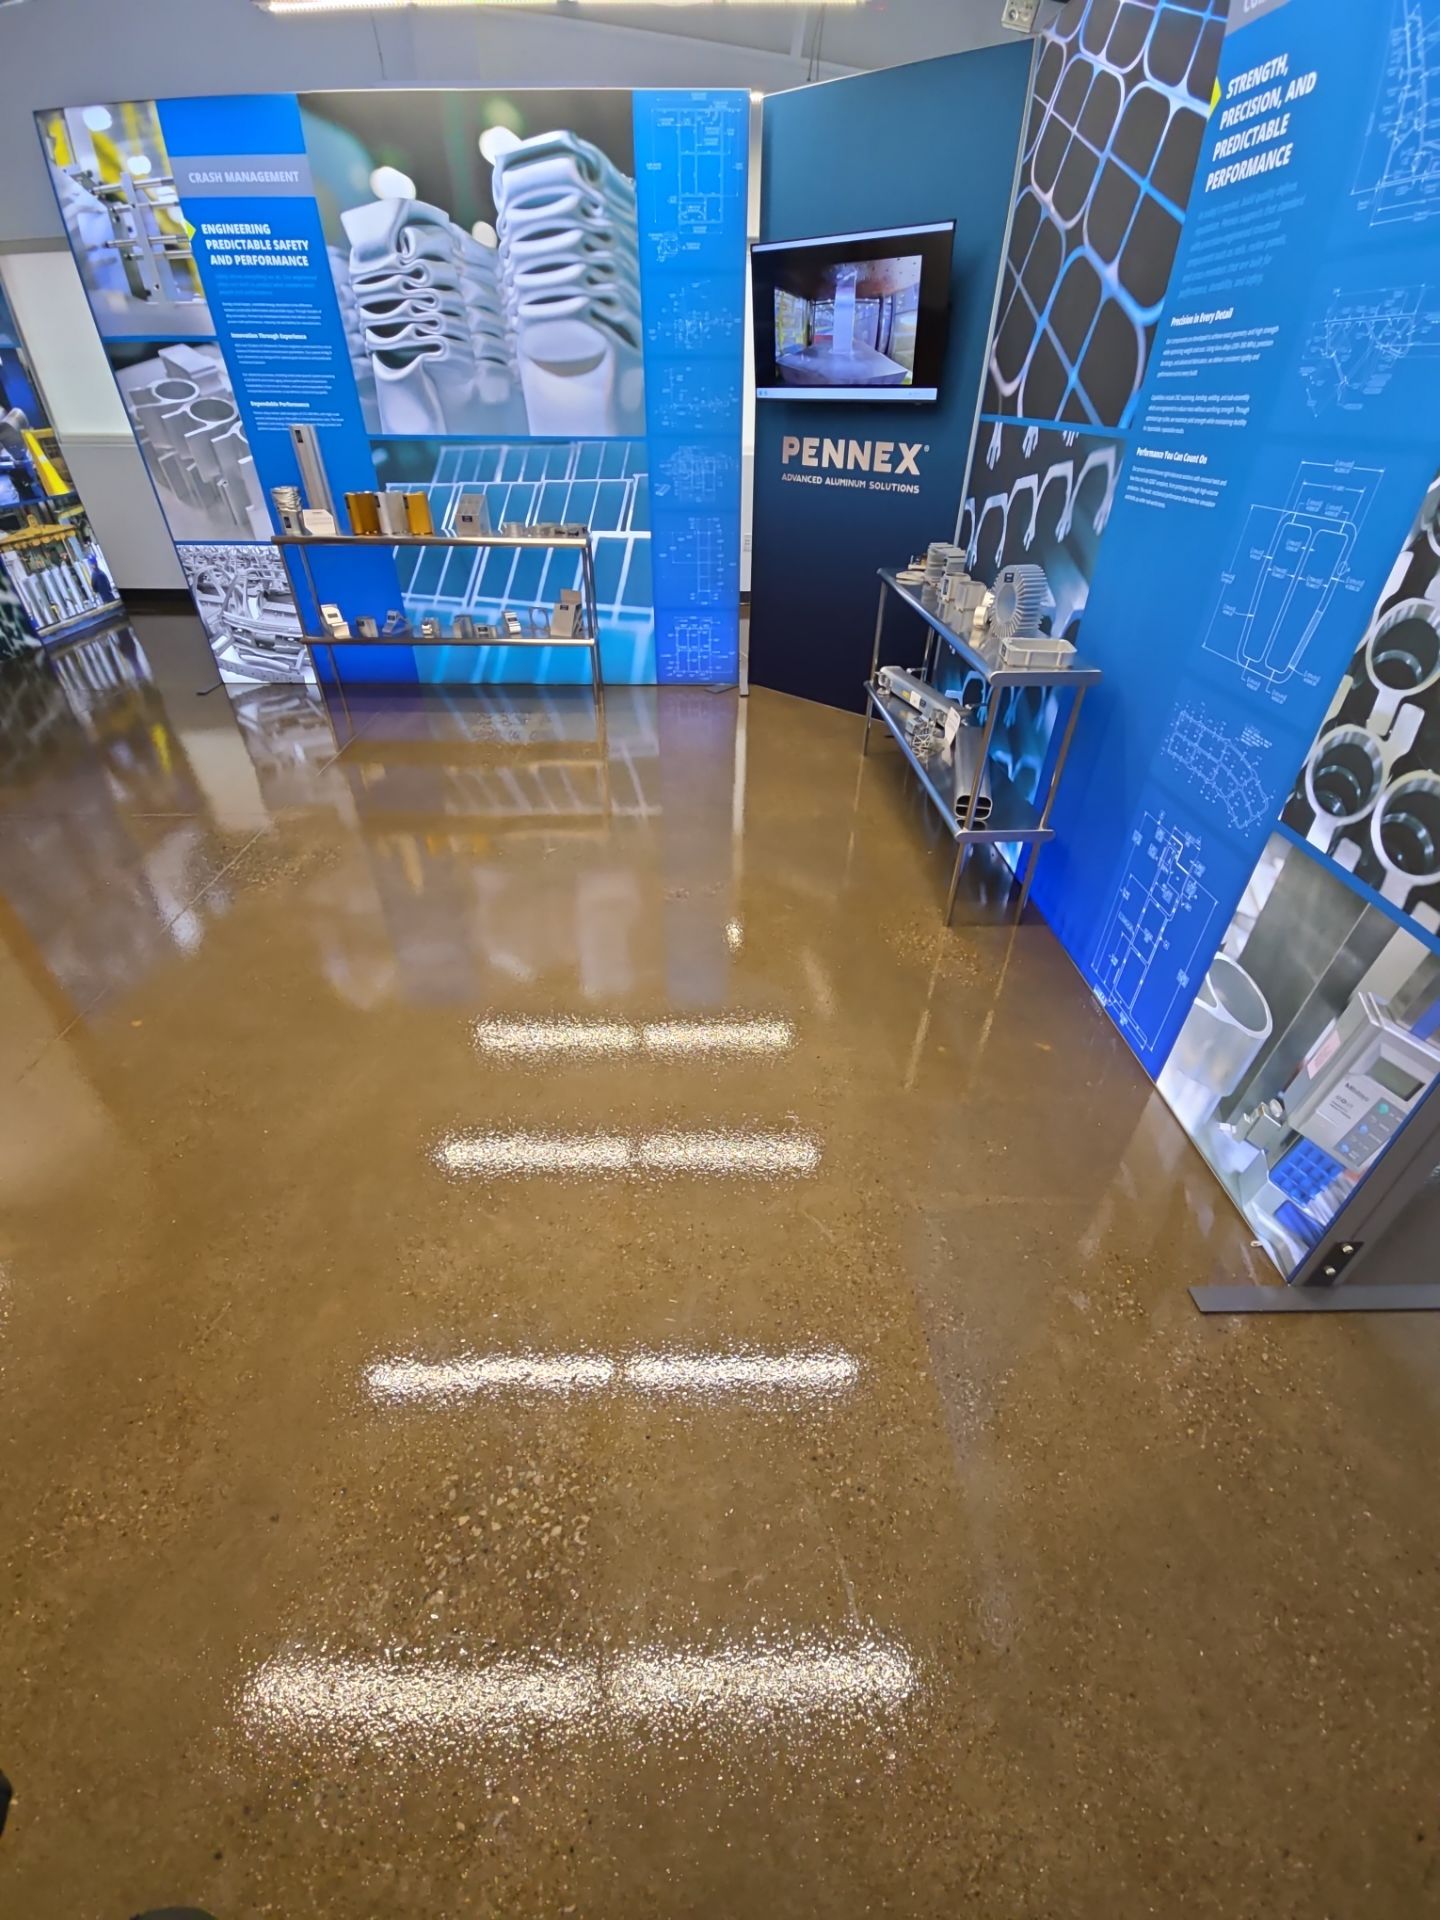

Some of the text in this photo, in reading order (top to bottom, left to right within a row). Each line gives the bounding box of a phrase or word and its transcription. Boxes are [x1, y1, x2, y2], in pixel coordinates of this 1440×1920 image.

[1226, 53, 1288, 100] STRENGTH,
[1219, 71, 1317, 131] PRECISION, AND
[1212, 113, 1291, 162] PREDICTABLE
[188, 171, 300, 184] CRASH MANAGEMENT
[1204, 142, 1294, 193] PERFORMANCE
[201, 223, 272, 235] ENGINEERING
[205, 239, 309, 251] PREDICTABLE SAFETY
[210, 254, 310, 267] AND PERFORMANCE
[781, 473, 921, 494] ADVANCED ALUMINUM SOLUTIONS
